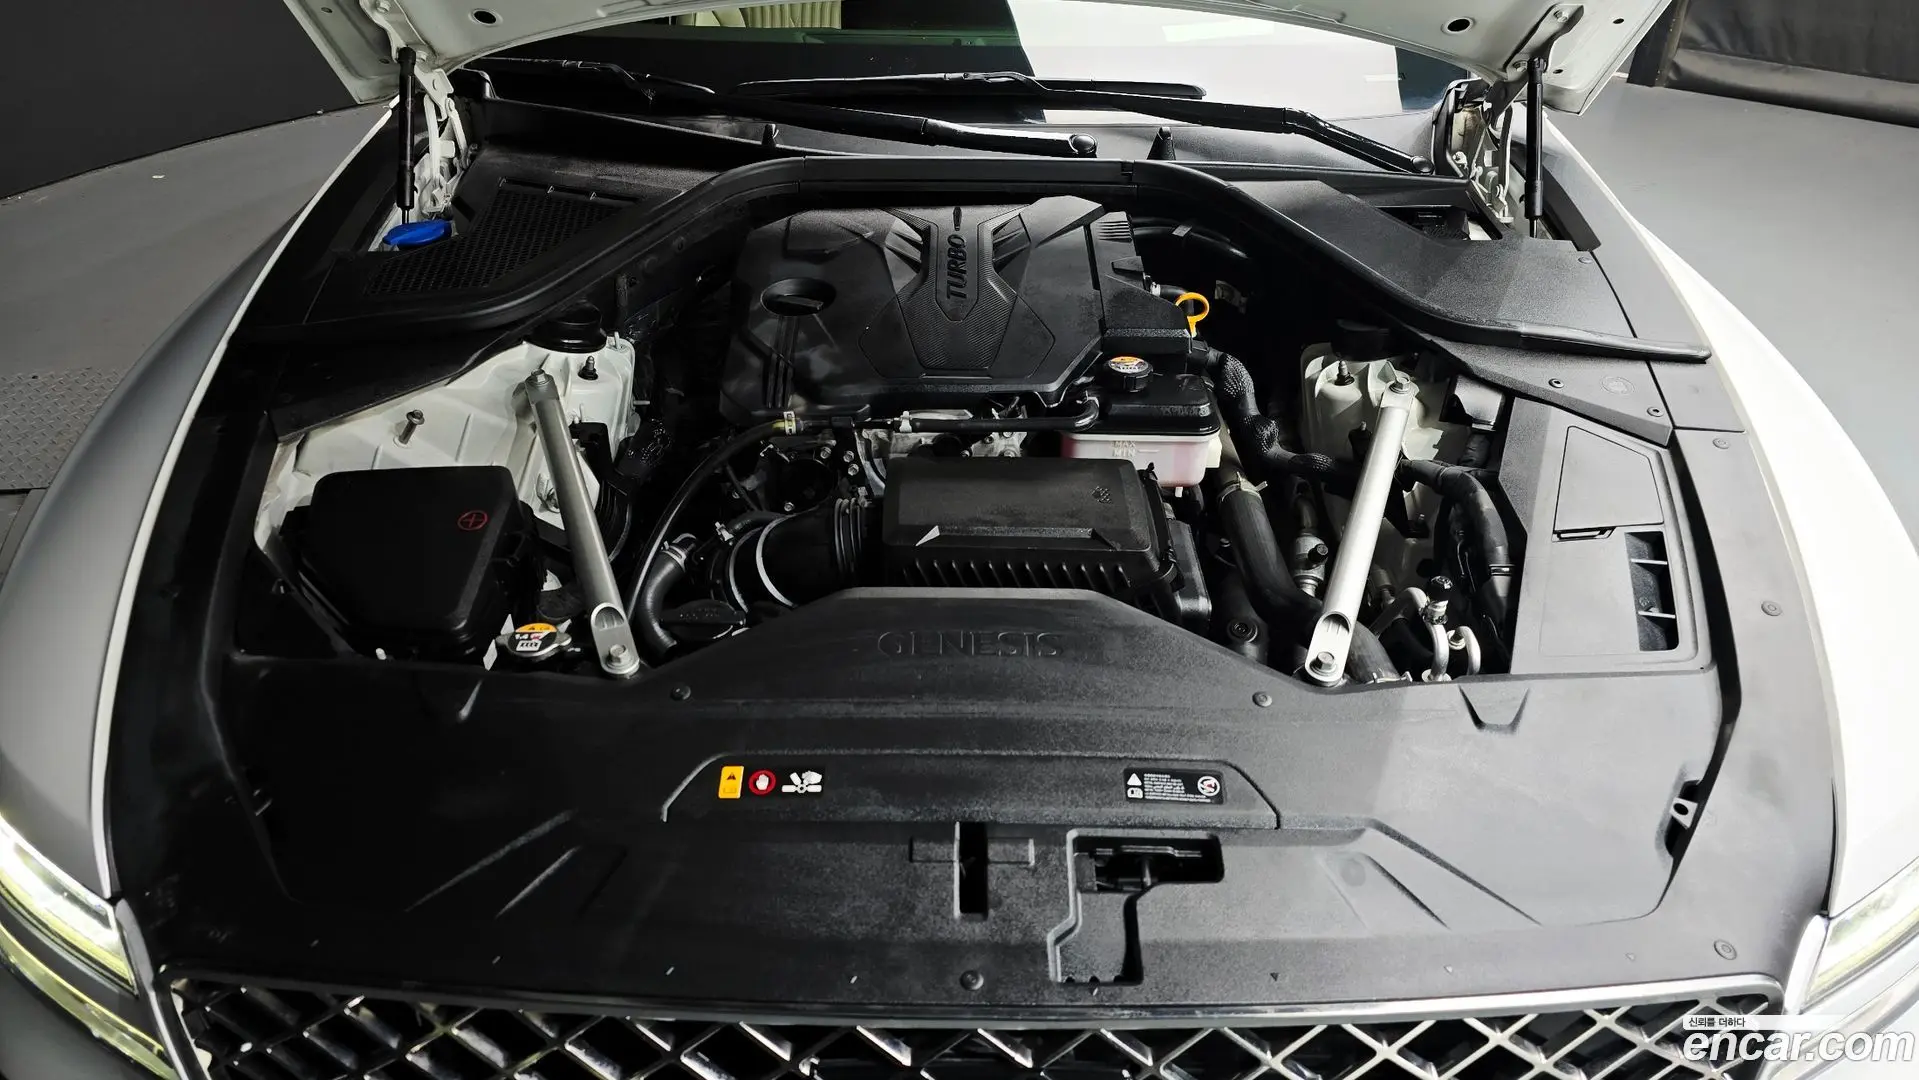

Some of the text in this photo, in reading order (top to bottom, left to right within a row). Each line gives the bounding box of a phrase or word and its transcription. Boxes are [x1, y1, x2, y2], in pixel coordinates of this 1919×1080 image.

[947, 234, 967, 299] TURBO
[1114, 449, 1136, 457] MIN
[877, 631, 1065, 657] GENESIS
